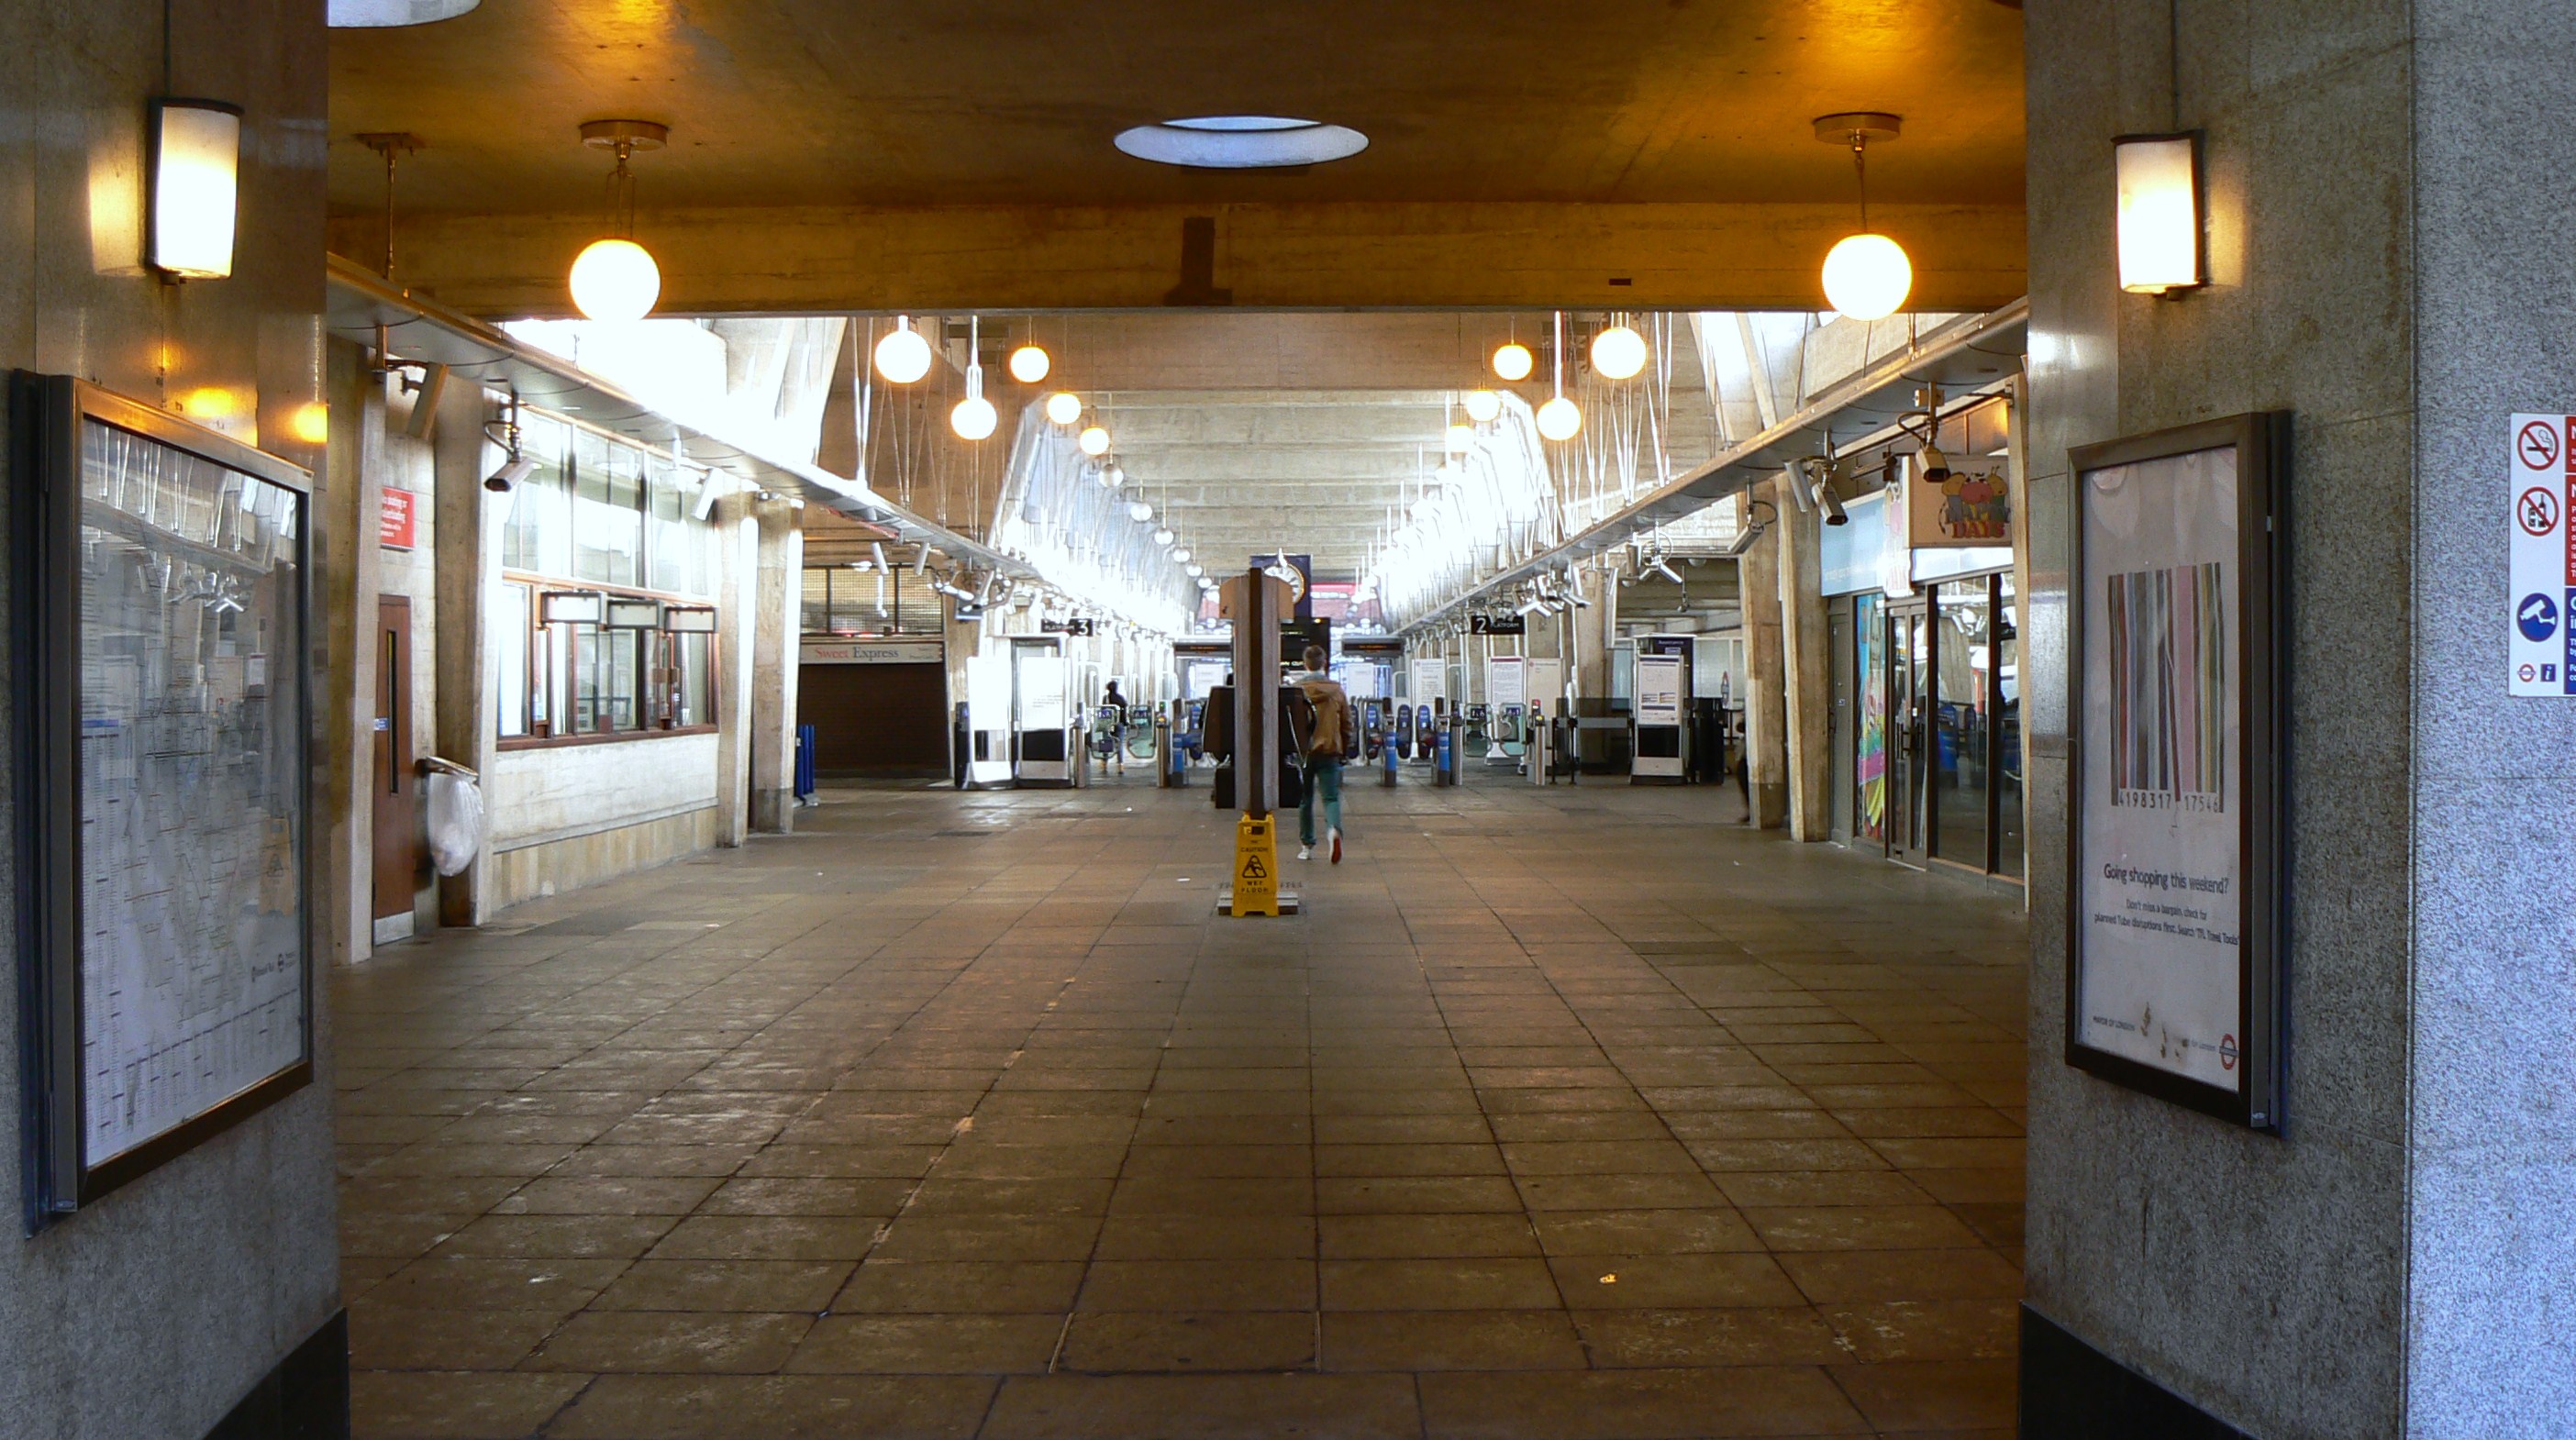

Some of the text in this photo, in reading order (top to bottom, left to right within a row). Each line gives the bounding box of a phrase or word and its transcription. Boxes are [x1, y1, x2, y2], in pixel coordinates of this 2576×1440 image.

[1952, 520, 2005, 538] DAYS
[1077, 619, 1089, 636] 3
[1476, 617, 1487, 634] 2
[815, 647, 849, 659] Sweet
[852, 646, 899, 661] Express
[2119, 791, 2219, 814] 4198317 17546
[2104, 863, 2229, 895] Going shopping this weekend?
[2126, 898, 2141, 911] Don't
[2142, 903, 2155, 912] miss
[2184, 906, 2198, 919] check
[2093, 912, 2116, 925] planned
[2132, 917, 2161, 932] disruptions
